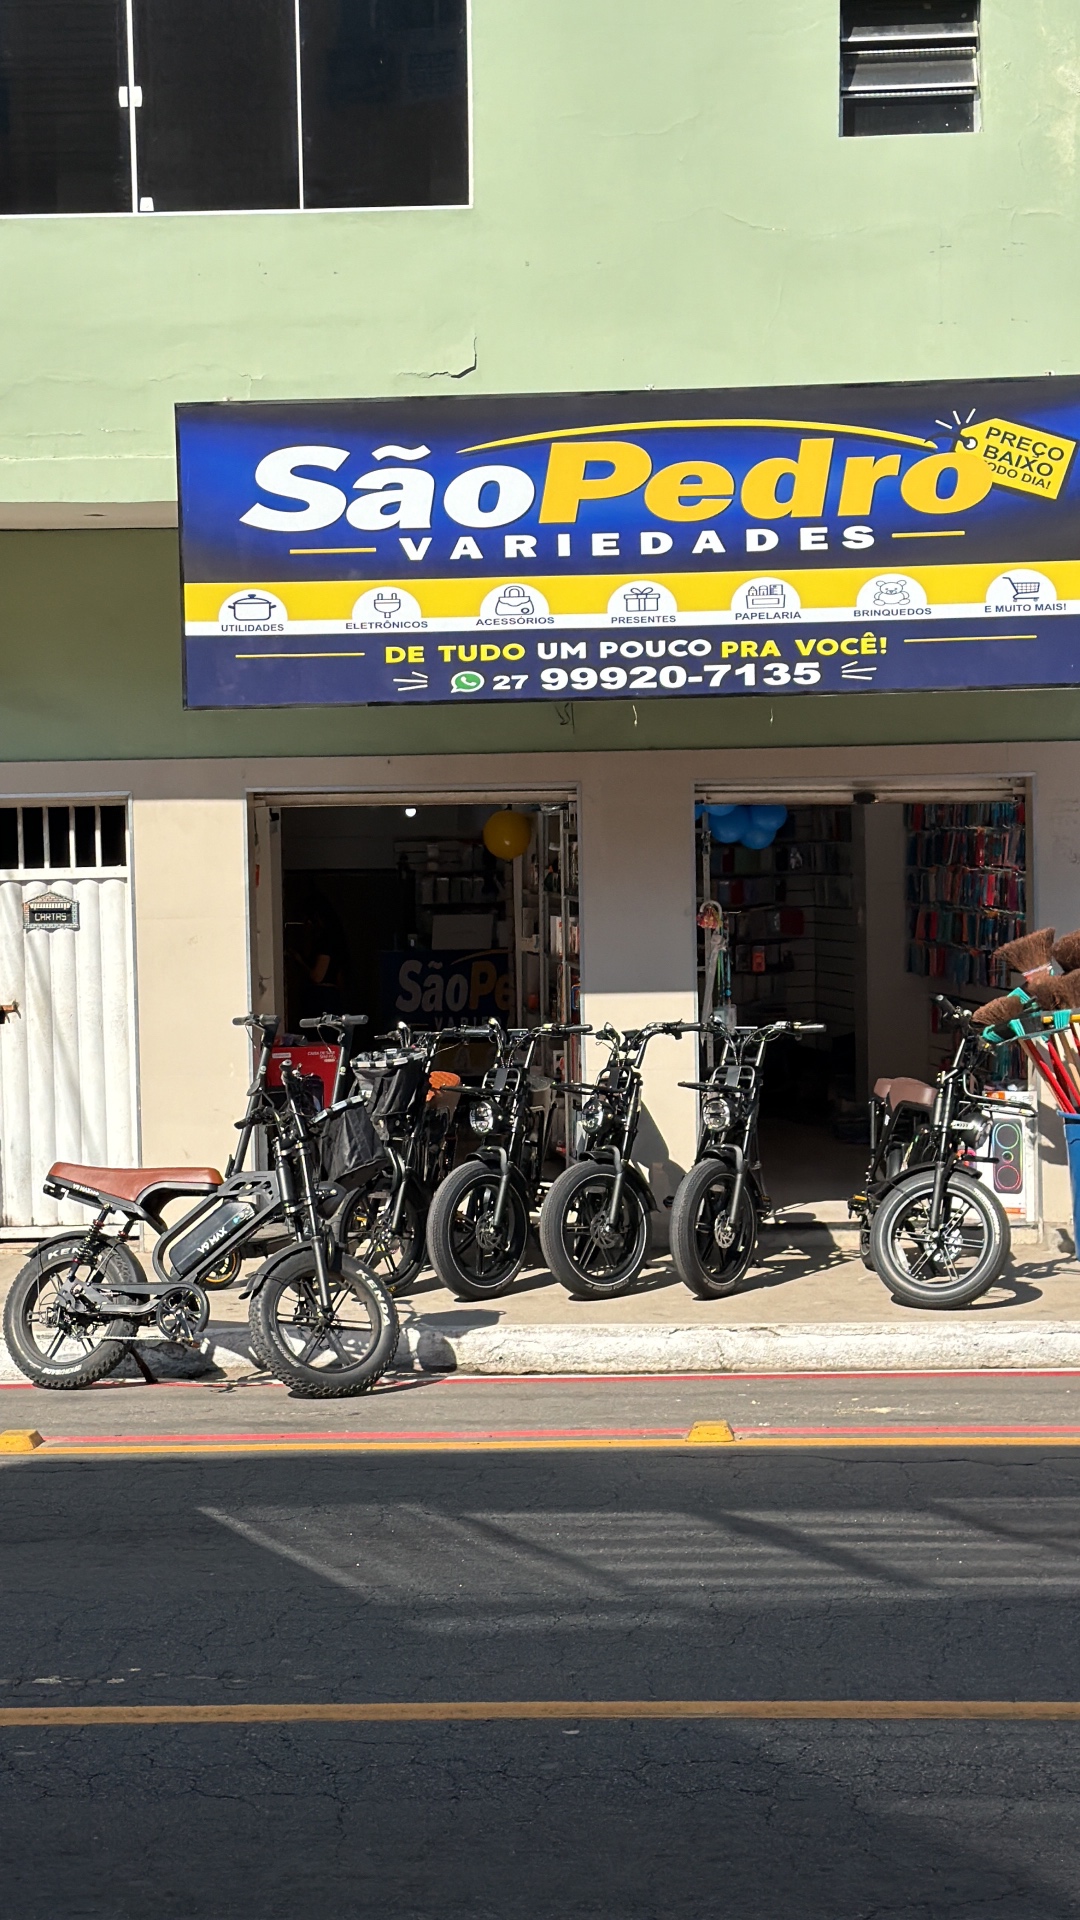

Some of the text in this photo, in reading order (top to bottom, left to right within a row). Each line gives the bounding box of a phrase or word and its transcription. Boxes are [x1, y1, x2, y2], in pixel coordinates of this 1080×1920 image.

[985, 426, 1065, 461] PREÇO
[983, 445, 1054, 476] BAIXO
[984, 460, 1052, 490] ODO DIA!
[398, 525, 876, 561] VARIEDADES
[853, 607, 932, 618] BRINQUEDOS
[984, 603, 1067, 613] E MUITO MAIS!
[475, 615, 555, 626] ACESSÓRIOS
[610, 615, 677, 625] PRESENTES
[735, 611, 802, 620] PAPELARIA
[220, 623, 285, 632] UTILIDADES
[345, 619, 429, 630] ELETRÔNICOS
[385, 631, 887, 664] DE TUDO UM POUCO PRA VOCÊ!
[492, 661, 821, 691] 27 99920-7135
[34, 912, 67, 922] CARTAS
[47, 1247, 82, 1260] KEN
[355, 1269, 391, 1327] KENDA
